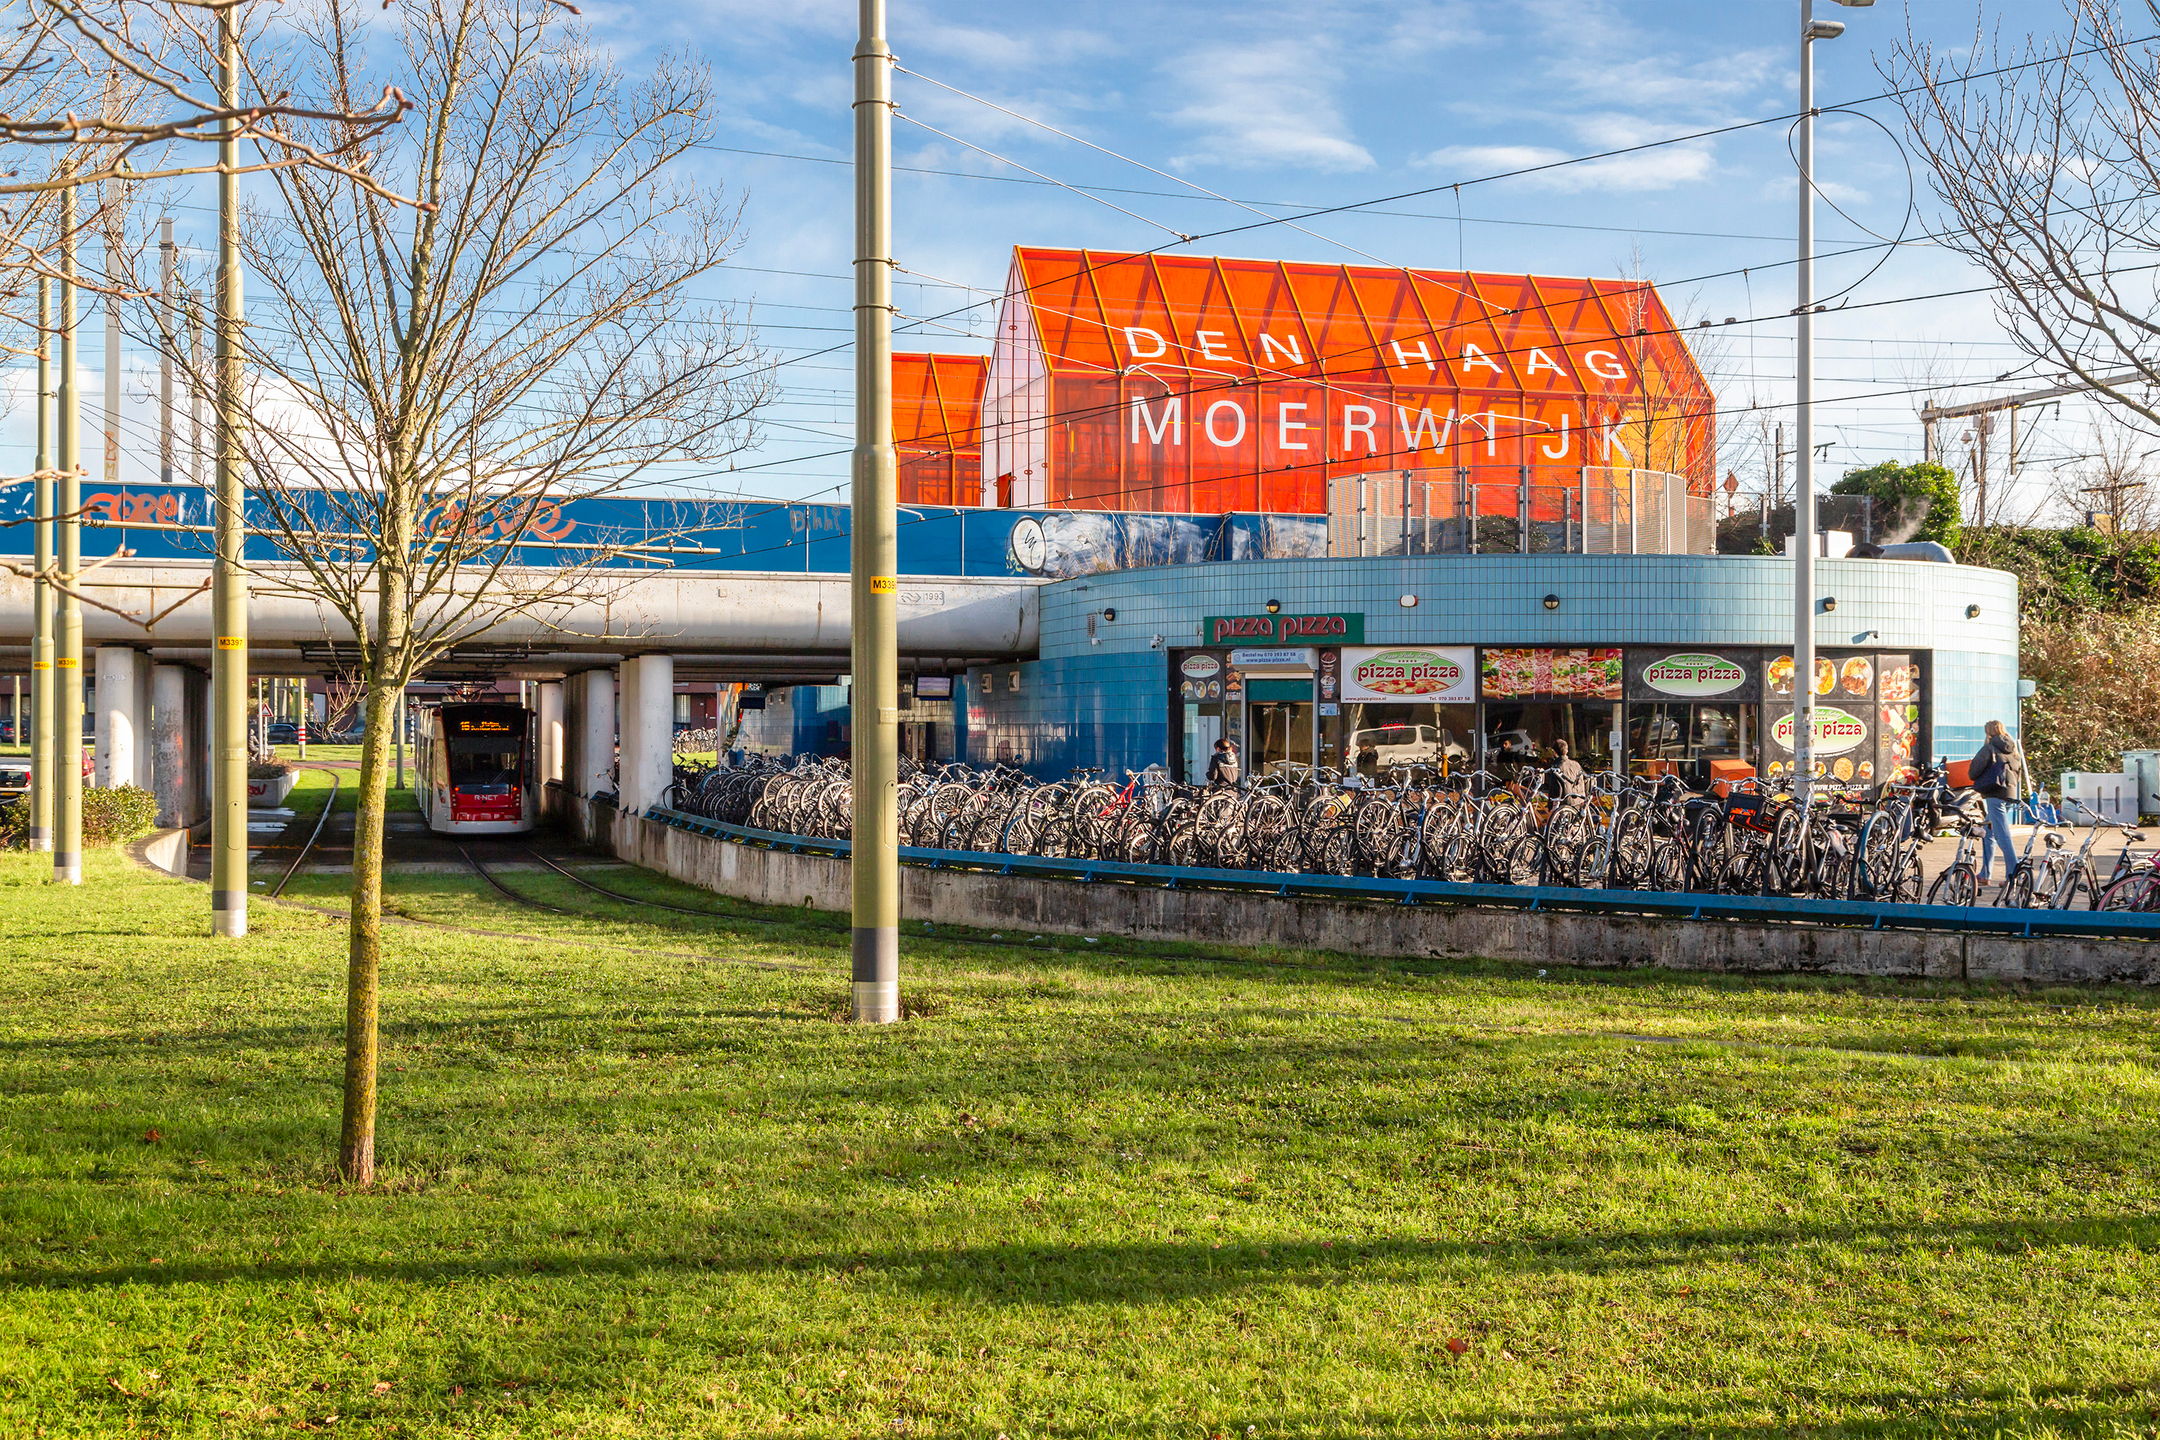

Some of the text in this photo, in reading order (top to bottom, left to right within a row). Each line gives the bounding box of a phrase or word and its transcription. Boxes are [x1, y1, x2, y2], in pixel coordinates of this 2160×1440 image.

[1123, 326, 1629, 380] DEN HAAG
[1131, 395, 1634, 462] MOERWIJK
[925, 592, 944, 601] 1993
[1213, 616, 1347, 642] pizza pizza
[219, 638, 243, 647] M3397
[1183, 662, 1219, 672] pizza pizza
[1357, 663, 1459, 681] pizza pizza
[1649, 666, 1741, 683] pizza pizza
[1822, 721, 1862, 739] pizza
